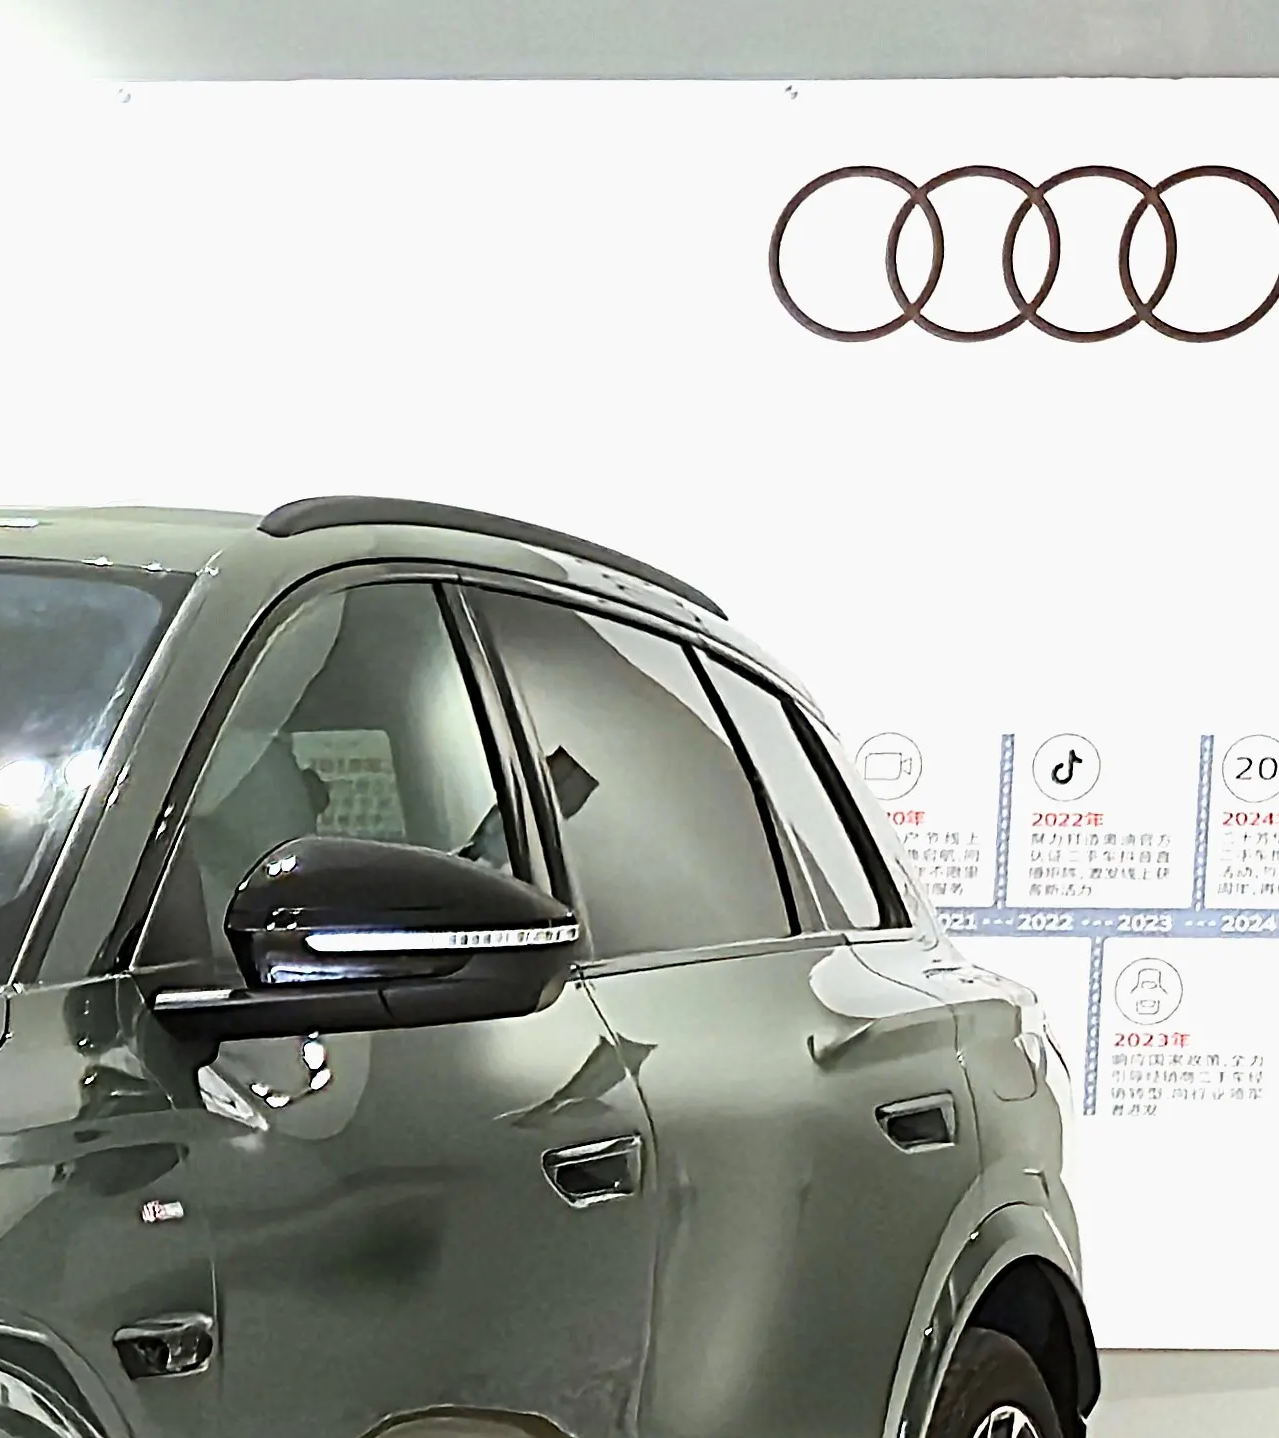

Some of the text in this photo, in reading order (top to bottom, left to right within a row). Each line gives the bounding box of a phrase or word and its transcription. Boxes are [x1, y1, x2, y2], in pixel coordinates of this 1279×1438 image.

[1234, 756, 1279, 781] 20
[1031, 811, 1105, 827] 2022年
[1016, 912, 1075, 932] 2022
[1116, 914, 1173, 932] 2023
[1220, 914, 1279, 933] 2024
[1113, 1031, 1191, 1049] 2023年
